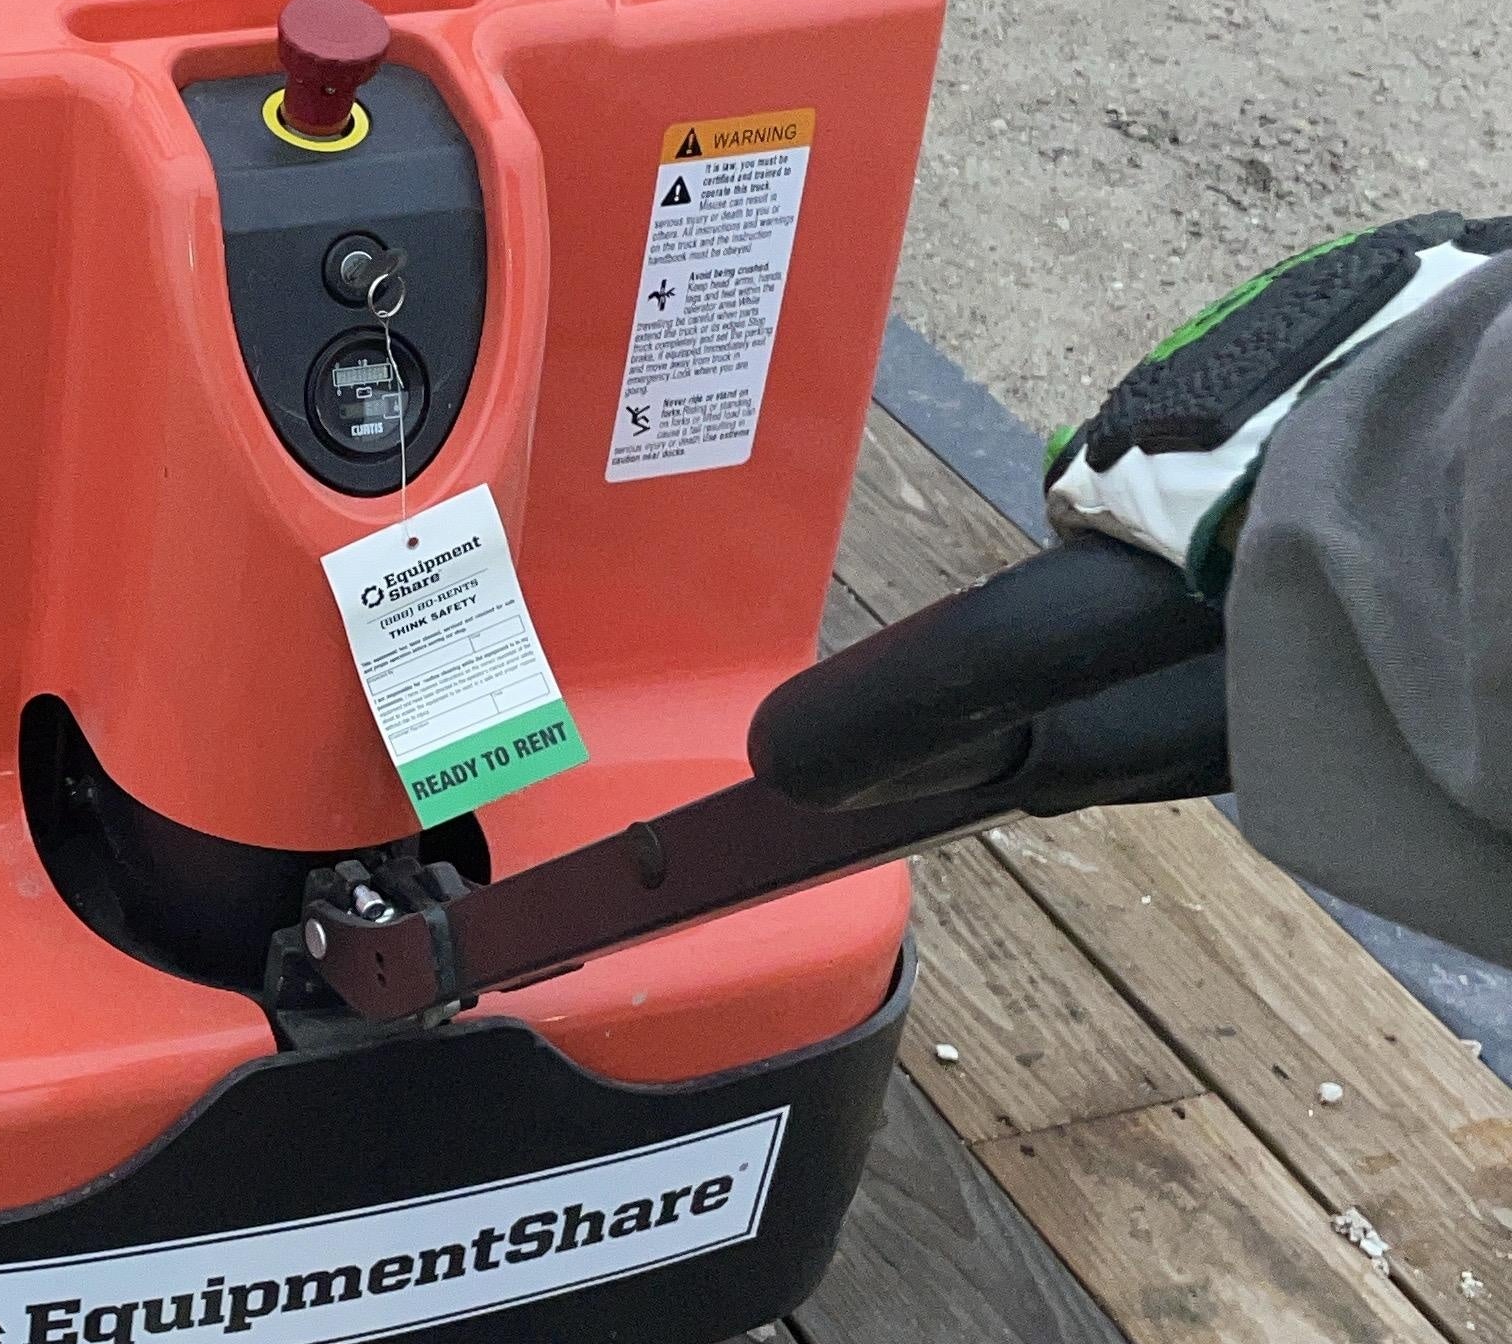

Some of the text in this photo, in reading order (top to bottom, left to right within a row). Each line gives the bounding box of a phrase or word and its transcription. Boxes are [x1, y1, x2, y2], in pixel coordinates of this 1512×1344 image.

[713, 124, 798, 149] WARNING
[351, 422, 383, 436] CURTIS
[383, 535, 482, 589] Equipment
[388, 570, 441, 603] Share
[389, 594, 477, 640] THINK SAFETY
[411, 720, 568, 801] READY TO RENT
